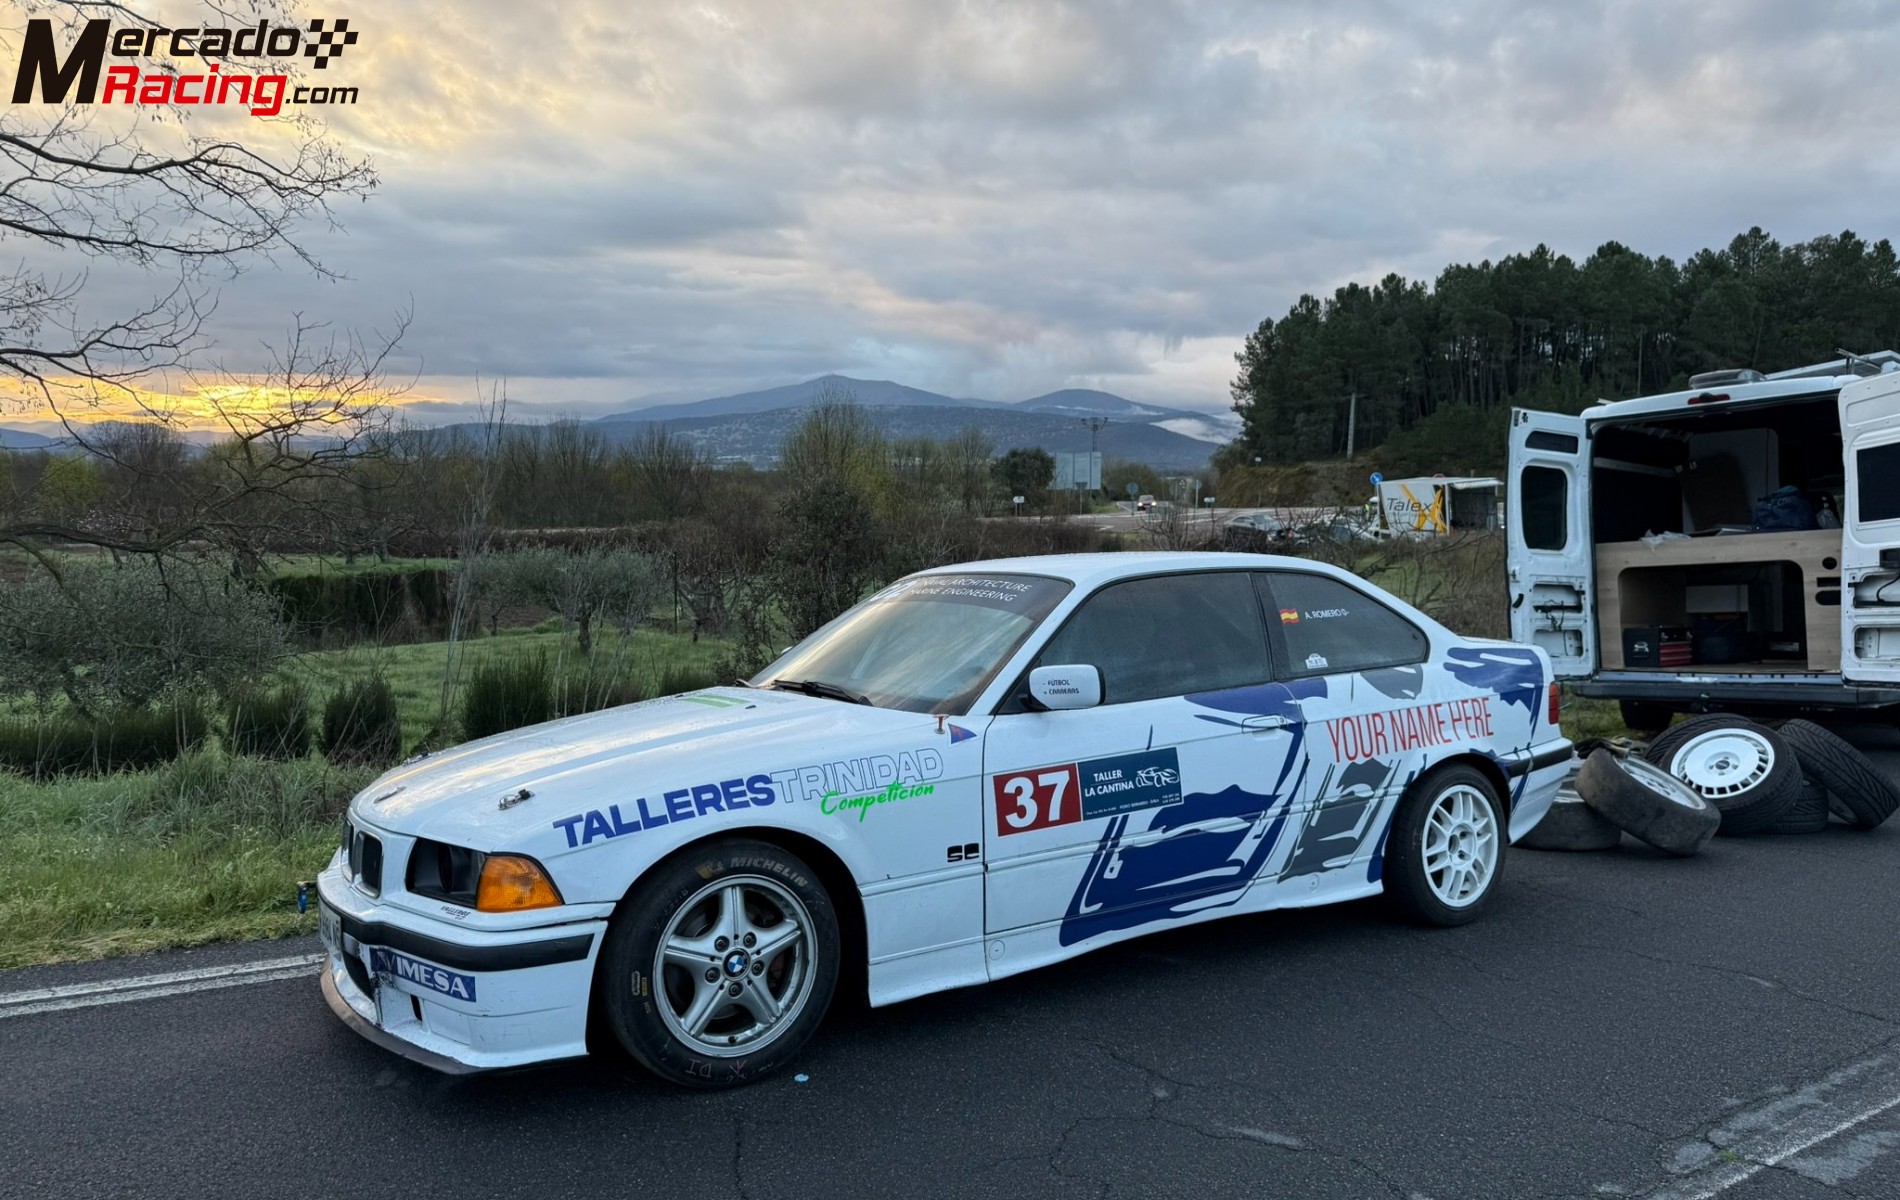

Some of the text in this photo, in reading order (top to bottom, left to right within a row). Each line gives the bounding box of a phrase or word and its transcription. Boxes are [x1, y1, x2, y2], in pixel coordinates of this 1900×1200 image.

[1387, 497, 1432, 512] Talex
[951, 579, 1033, 593] ARCHITECTURE
[942, 588, 1018, 602] ENGINEERING
[1312, 608, 1341, 618] ROMERO
[1326, 713, 1388, 763] YOUR
[1389, 703, 1452, 752] NAME
[1093, 769, 1123, 782] TALLER
[1084, 780, 1134, 797] LA CANTINA
[1003, 770, 1070, 828] 37
[730, 857, 809, 887] MICHELIN
